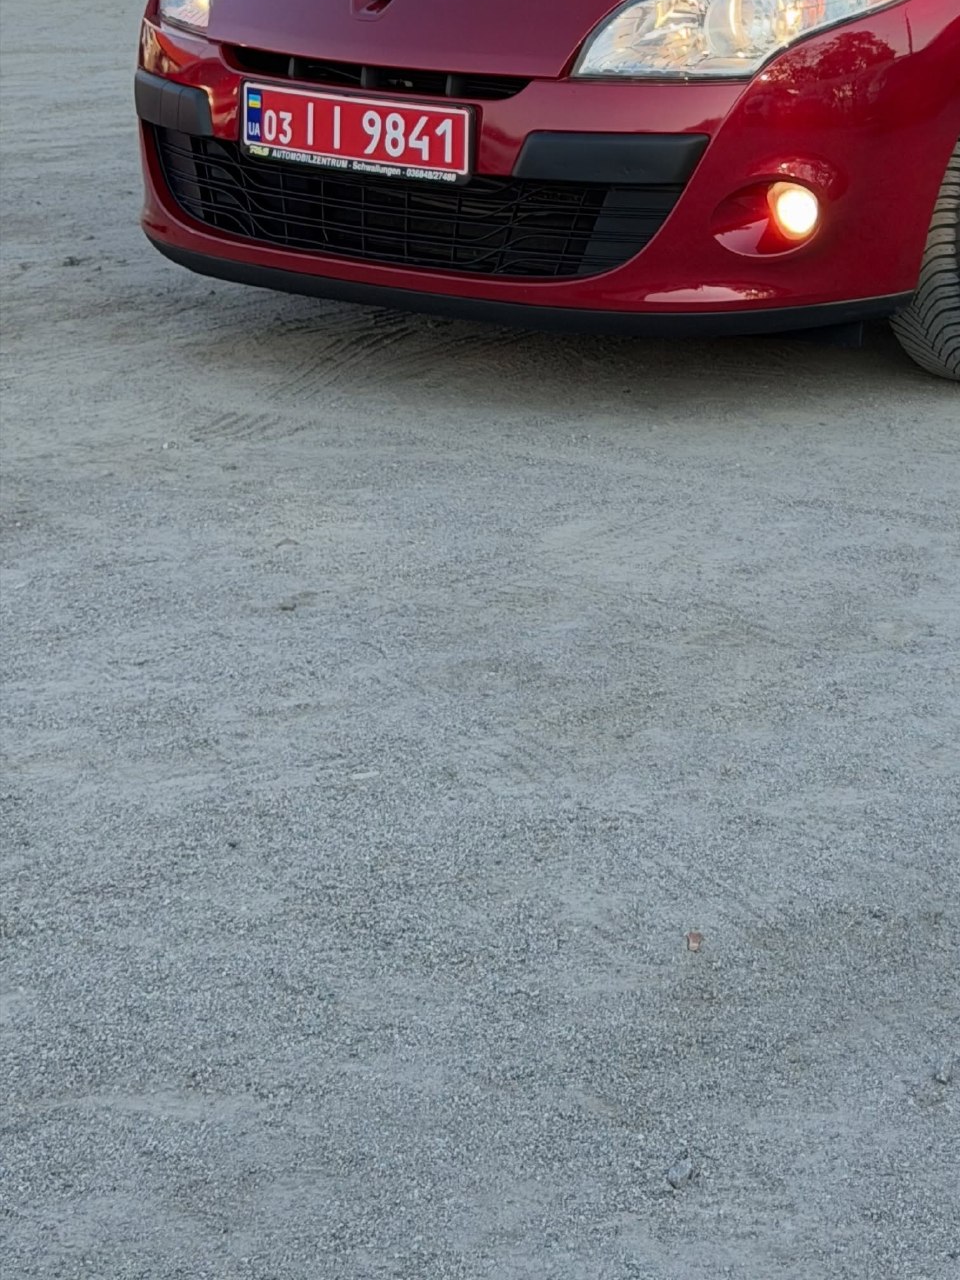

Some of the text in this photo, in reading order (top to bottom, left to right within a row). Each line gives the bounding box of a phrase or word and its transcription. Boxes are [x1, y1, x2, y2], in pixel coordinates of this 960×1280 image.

[248, 121, 261, 137] UA
[263, 109, 293, 145] 03
[362, 110, 453, 163] 9841
[271, 149, 348, 169] AUTOMOBILZENTRUM
